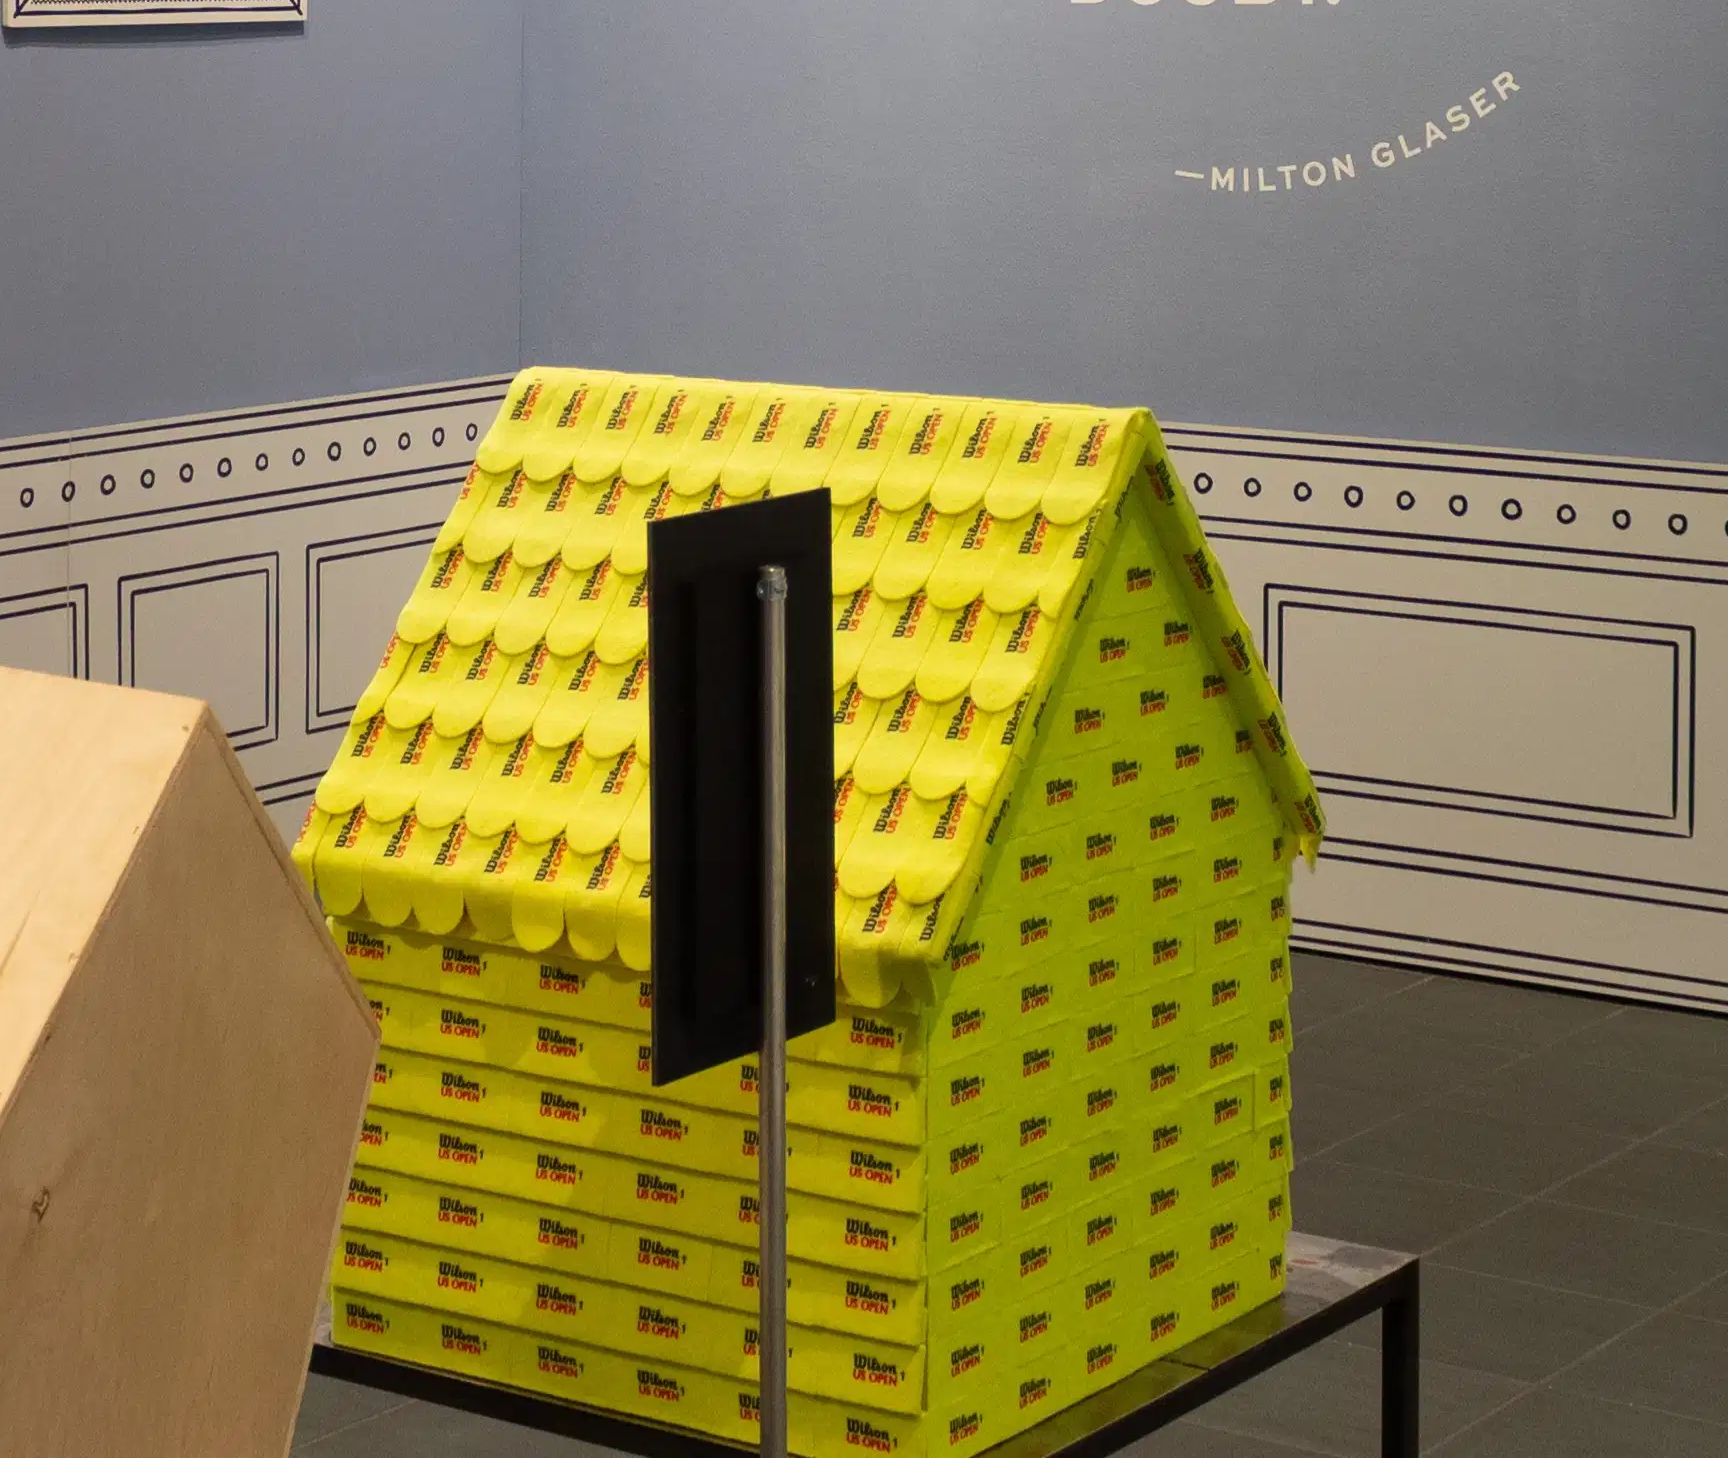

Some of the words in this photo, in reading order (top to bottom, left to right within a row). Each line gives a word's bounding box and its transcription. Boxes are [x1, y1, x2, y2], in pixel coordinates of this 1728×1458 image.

[1372, 72, 1520, 167] GLASER
[510, 384, 534, 420] Wilson
[605, 392, 629, 430] Wilson
[520, 410, 532, 422] US
[616, 417, 627, 430] US
[653, 395, 678, 434] Wilson
[665, 421, 675, 433] US
[962, 418, 987, 458] Wilson
[1017, 423, 1043, 463] Wilson
[1075, 425, 1099, 466] Wilson
[974, 446, 986, 458] US
[1029, 450, 1041, 463] US
[1087, 454, 1098, 466] US
[892, 595, 916, 637] Wilson
[904, 625, 916, 638] US
[1005, 610, 1032, 653] Wilson
[1018, 640, 1029, 653] US
[1139, 689, 1166, 706] Wilson
[1074, 707, 1101, 724] Wilson
[1111, 759, 1138, 776] Wilson
[1046, 778, 1074, 796] Wilson
[433, 824, 459, 865] Wilson
[484, 831, 511, 873] Wilson
[445, 854, 456, 866] US
[495, 861, 508, 874] US
[1020, 854, 1048, 874] Wilson
[346, 931, 384, 949] Wilson
[345, 945, 358, 955] US
[360, 948, 384, 960] OPEN
[442, 946, 481, 964] Wilson
[441, 958, 454, 973] US
[454, 961, 481, 977] OPEN
[539, 964, 580, 984] Wilson
[1088, 959, 1115, 977] Wilson
[539, 976, 553, 991] US
[552, 980, 580, 995] OPEN
[1021, 984, 1049, 1003] Wilson
[441, 1009, 480, 1027] Wilson
[852, 1016, 894, 1037] Wilson
[951, 1009, 981, 1028] Wilson
[439, 1021, 453, 1035] US
[453, 1023, 480, 1039] OPEN
[537, 1026, 577, 1046] Wilson
[850, 1031, 865, 1044] US
[865, 1034, 895, 1049] OPEN
[535, 1038, 550, 1053] US
[549, 1043, 578, 1058] OPEN
[1022, 1048, 1050, 1067] Wilson
[848, 1084, 891, 1106] Wilson
[847, 1096, 862, 1112] US
[863, 1101, 893, 1118] OPEN
[850, 1150, 894, 1172] Wilson
[949, 1142, 979, 1164] Wilson
[848, 1165, 863, 1178] US
[864, 1168, 893, 1185] OPEN
[846, 1217, 890, 1240] Wilson
[345, 1241, 384, 1261] Wilson
[844, 1232, 859, 1247] US
[860, 1234, 889, 1252] OPEN
[344, 1253, 357, 1267] US
[357, 1256, 383, 1272] OPEN
[438, 1262, 478, 1282] Wilson
[437, 1275, 450, 1288] US
[450, 1277, 477, 1293] OPEN
[537, 1283, 577, 1305] Wilson
[535, 1296, 549, 1311] US
[547, 1297, 577, 1316] OPEN
[638, 1305, 679, 1328] Wilson
[636, 1320, 652, 1334] US
[651, 1323, 680, 1340] OPEN
[853, 1353, 898, 1375] Wilson
[852, 1367, 867, 1382] US
[868, 1371, 898, 1387] OPEN
